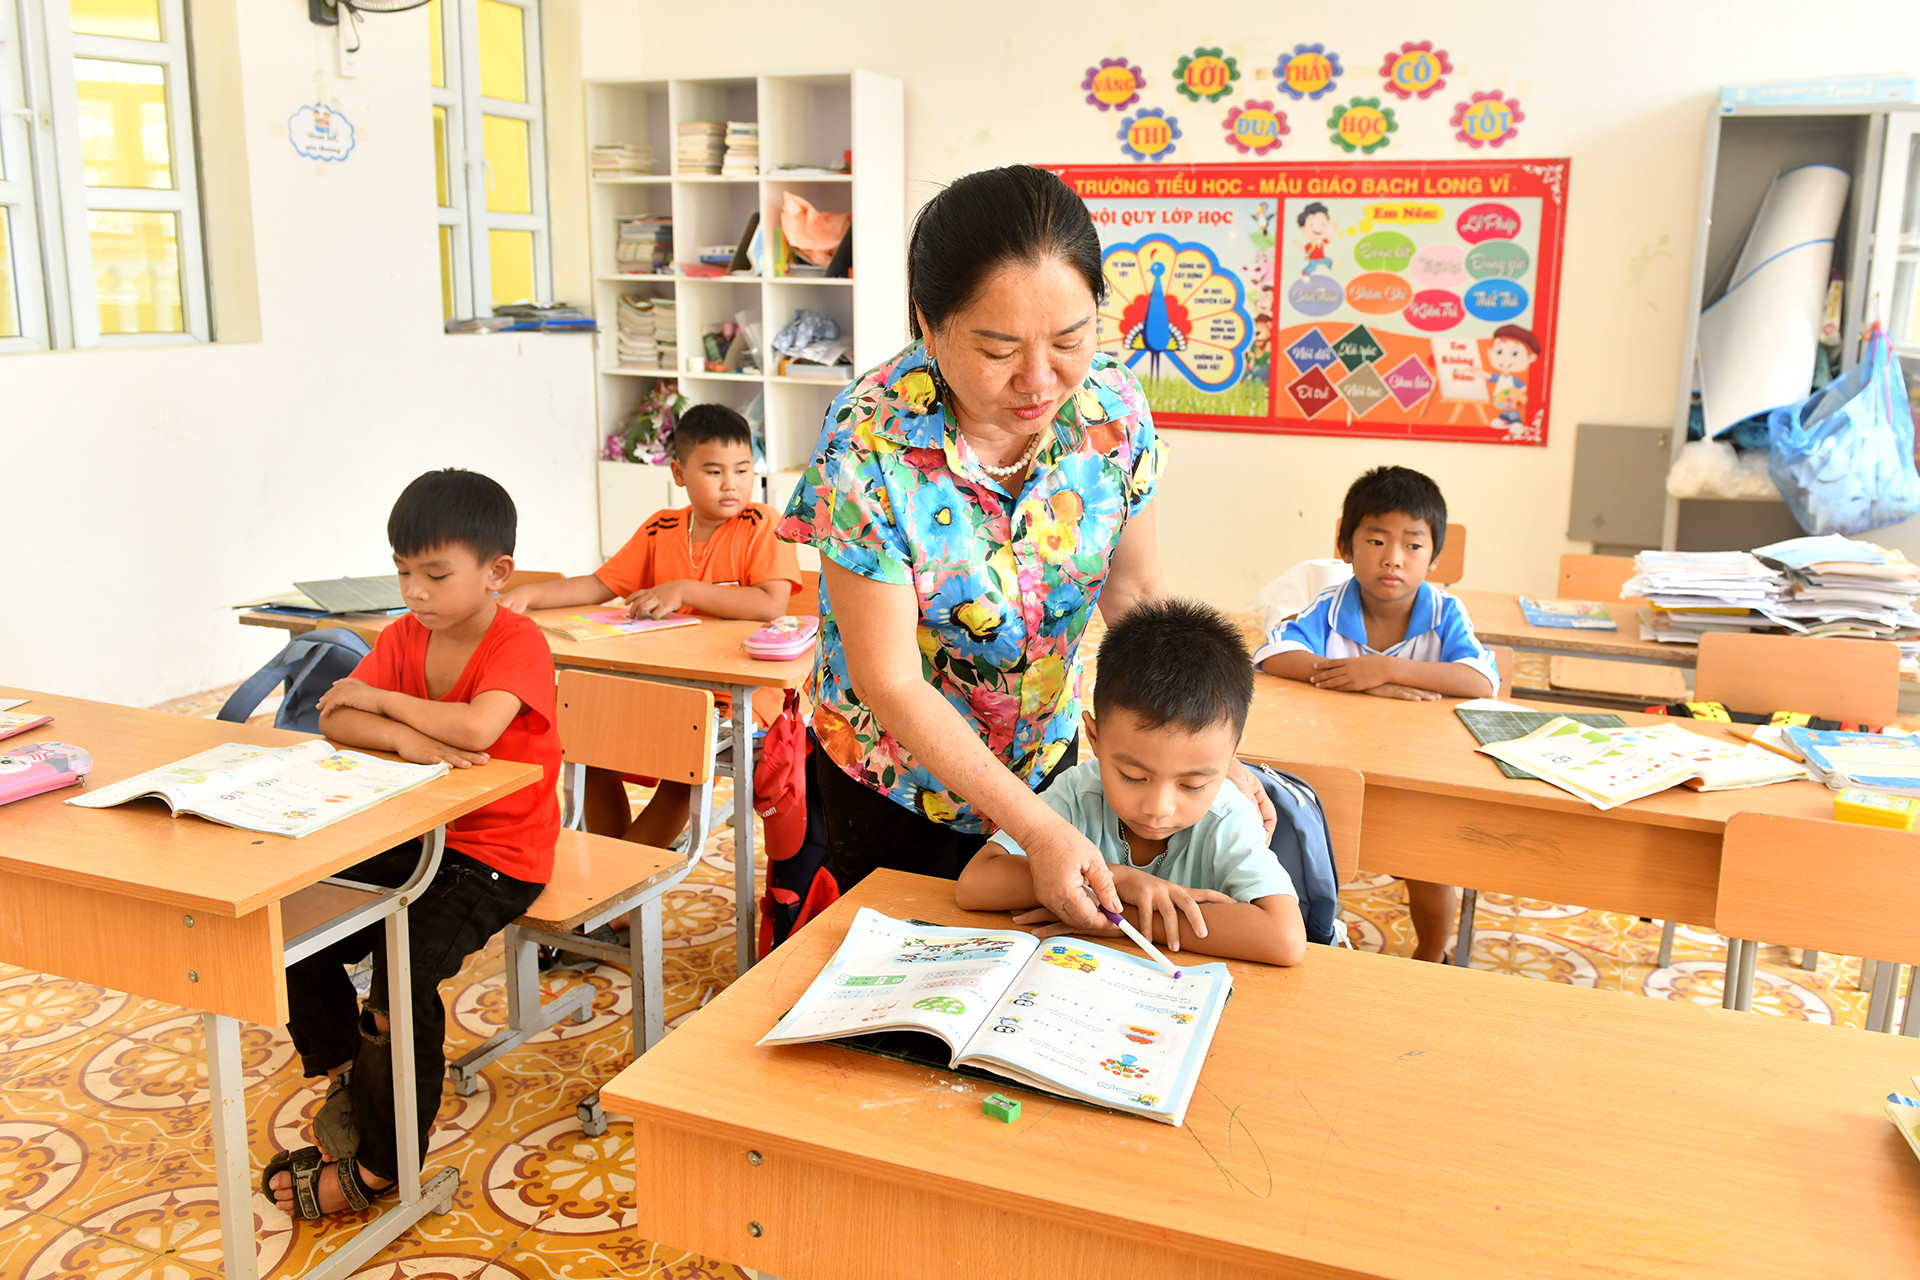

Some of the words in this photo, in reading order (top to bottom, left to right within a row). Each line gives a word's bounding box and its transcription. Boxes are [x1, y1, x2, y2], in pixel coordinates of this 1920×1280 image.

[1186, 59, 1227, 88] LỜI
[1396, 54, 1432, 84] CÔ
[1131, 126, 1168, 145] THI
[1236, 117, 1278, 138] ĐUA
[1341, 115, 1385, 139] HỌC
[1465, 102, 1512, 135] TỐT
[1073, 176, 1150, 195] TRƯỜNG
[1155, 172, 1197, 194] TIỂU
[1202, 178, 1243, 197] HỌC
[1259, 172, 1302, 194] MẪU
[1307, 174, 1357, 194] GIÁO
[1361, 178, 1418, 198] BẠCH
[1424, 177, 1483, 194] LONG
[1489, 173, 1511, 193] VĨ
[1121, 211, 1157, 226] QUY
[1161, 208, 1193, 224] LỚP
[1198, 211, 1233, 226] HỌC
[1373, 207, 1398, 219] Em
